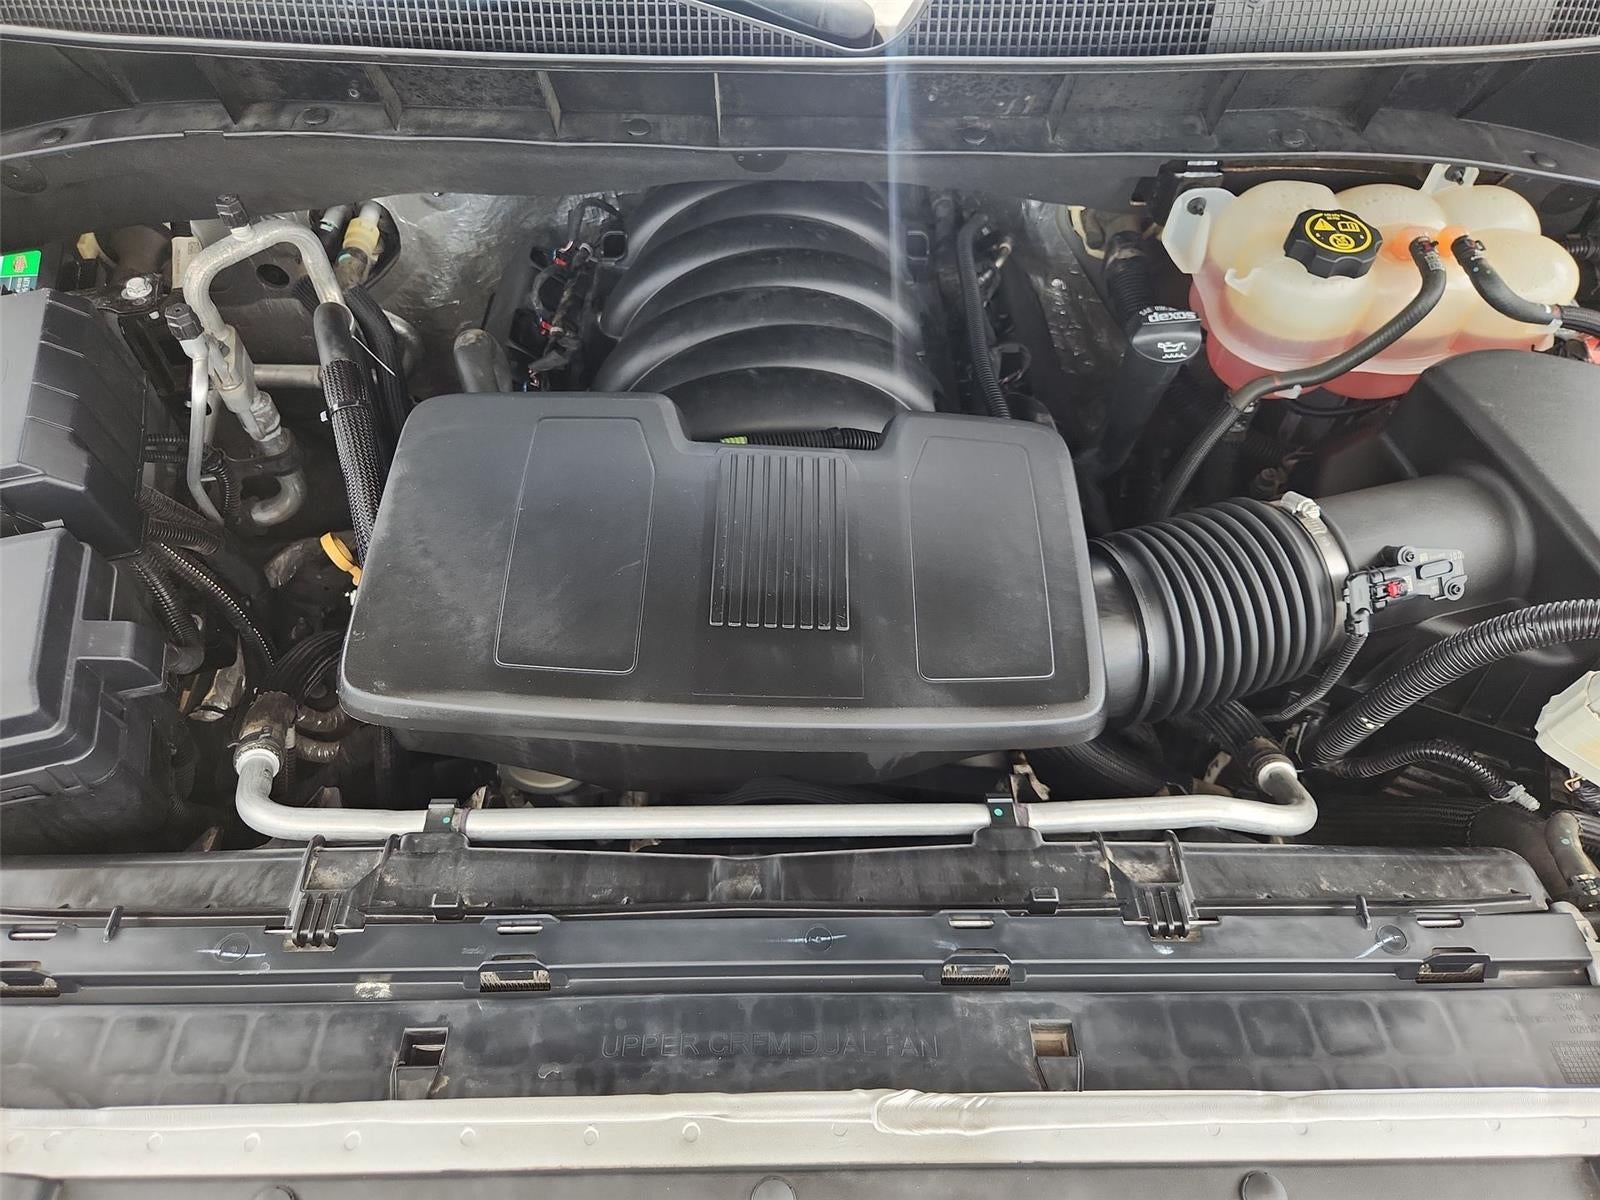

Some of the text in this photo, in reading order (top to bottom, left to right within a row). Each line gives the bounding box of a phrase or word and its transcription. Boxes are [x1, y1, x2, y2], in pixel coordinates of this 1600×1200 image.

[1148, 311, 1197, 322] dexos
[600, 1031, 943, 1058] UPPER CRFM DUAL FAN
